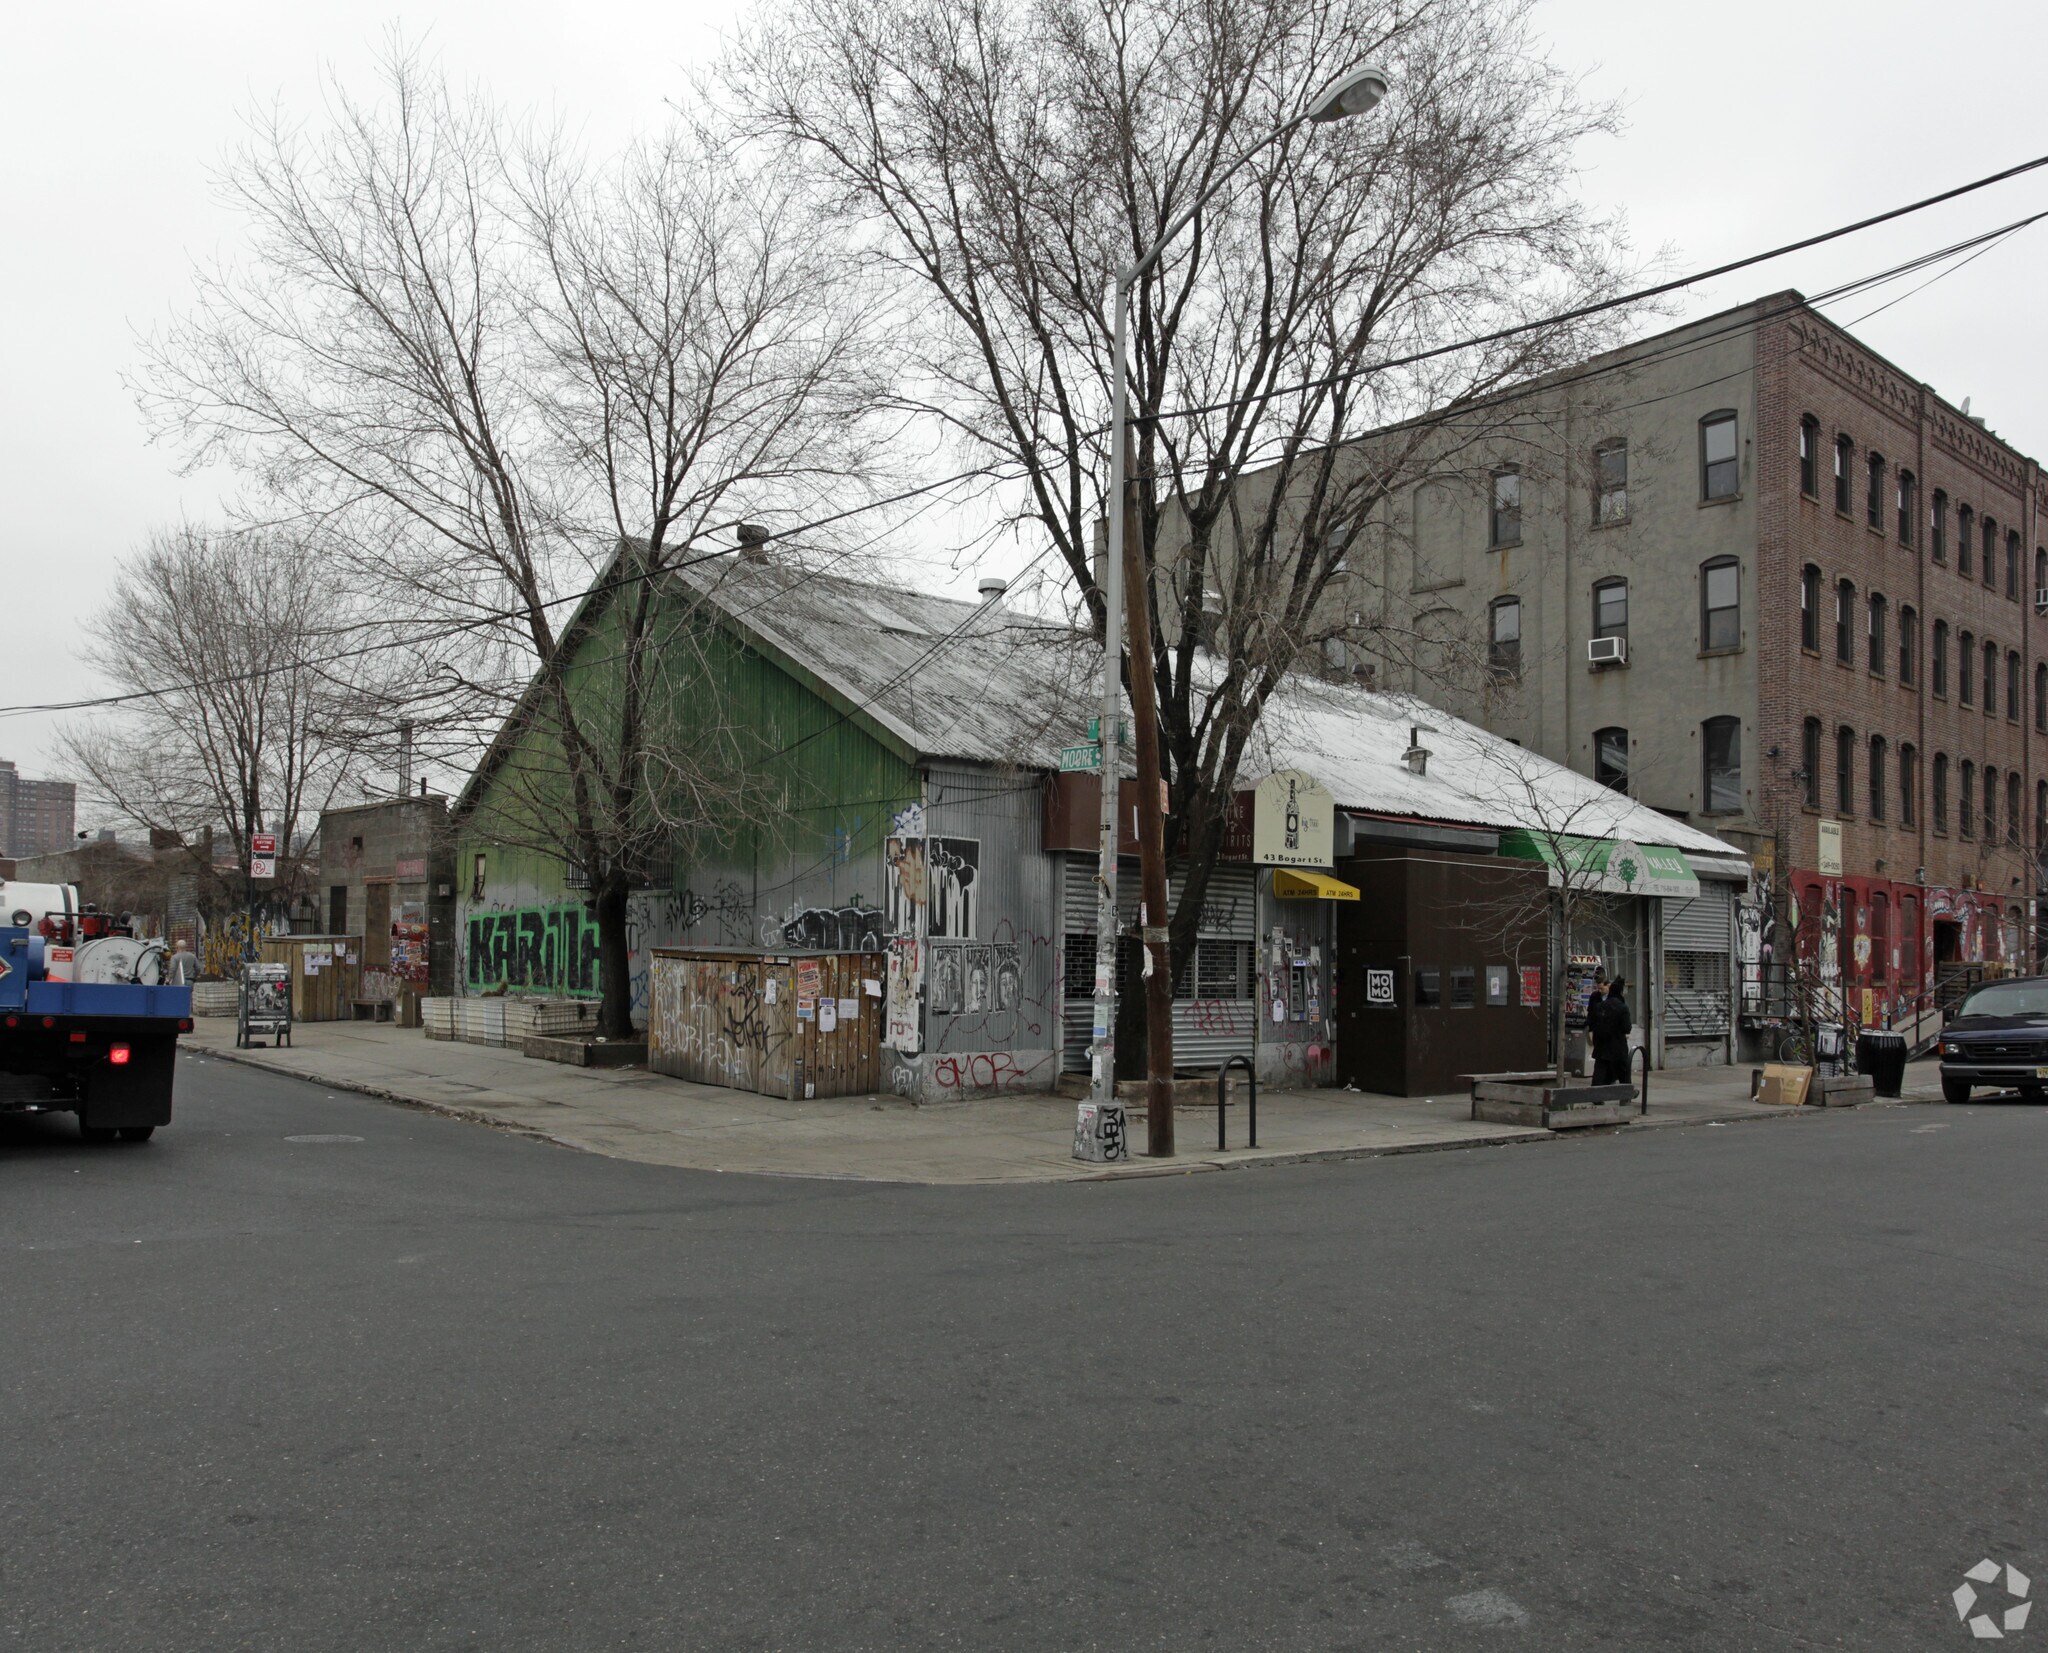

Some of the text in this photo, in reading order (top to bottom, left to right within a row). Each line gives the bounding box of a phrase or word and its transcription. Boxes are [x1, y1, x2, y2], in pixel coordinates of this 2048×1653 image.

[1263, 853, 1326, 864] 43 Bogart St.
[1646, 856, 1684, 874] VALLEY
[1325, 889, 1336, 897] ATM
[1570, 955, 1597, 963] ATM
[1371, 974, 1390, 986] MO
[1371, 987, 1390, 999] MO
